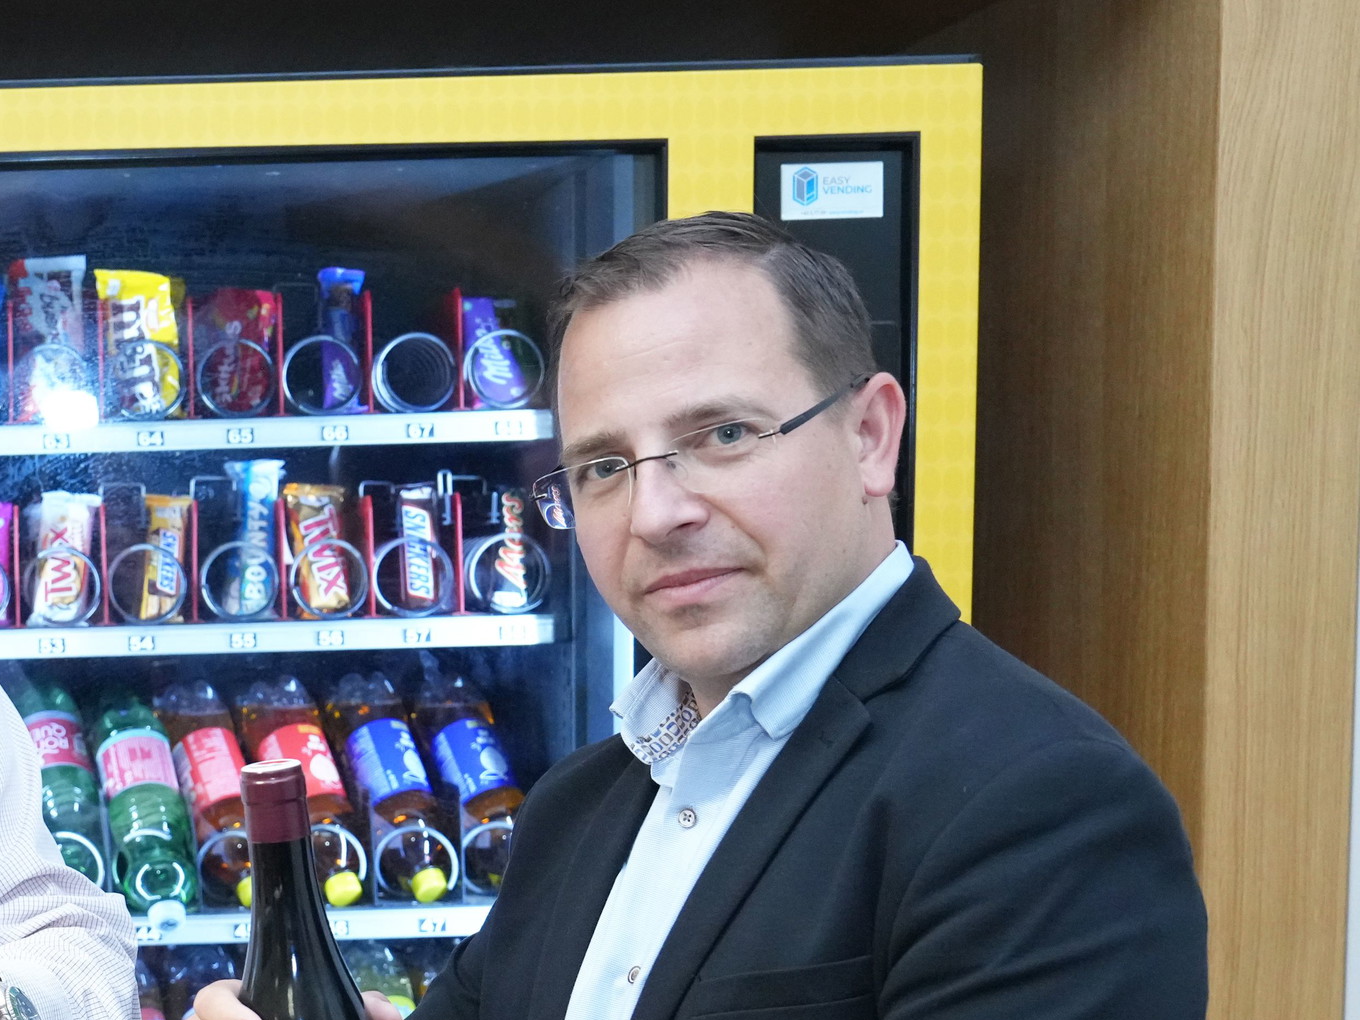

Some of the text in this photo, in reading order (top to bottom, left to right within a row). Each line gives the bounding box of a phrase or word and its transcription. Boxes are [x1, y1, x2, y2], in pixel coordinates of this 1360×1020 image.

[823, 176, 851, 186] EASY
[823, 184, 873, 196] VENDING
[227, 427, 255, 444] 65
[407, 423, 435, 439] 67
[44, 526, 73, 603] TWX
[418, 918, 446, 932] 47
